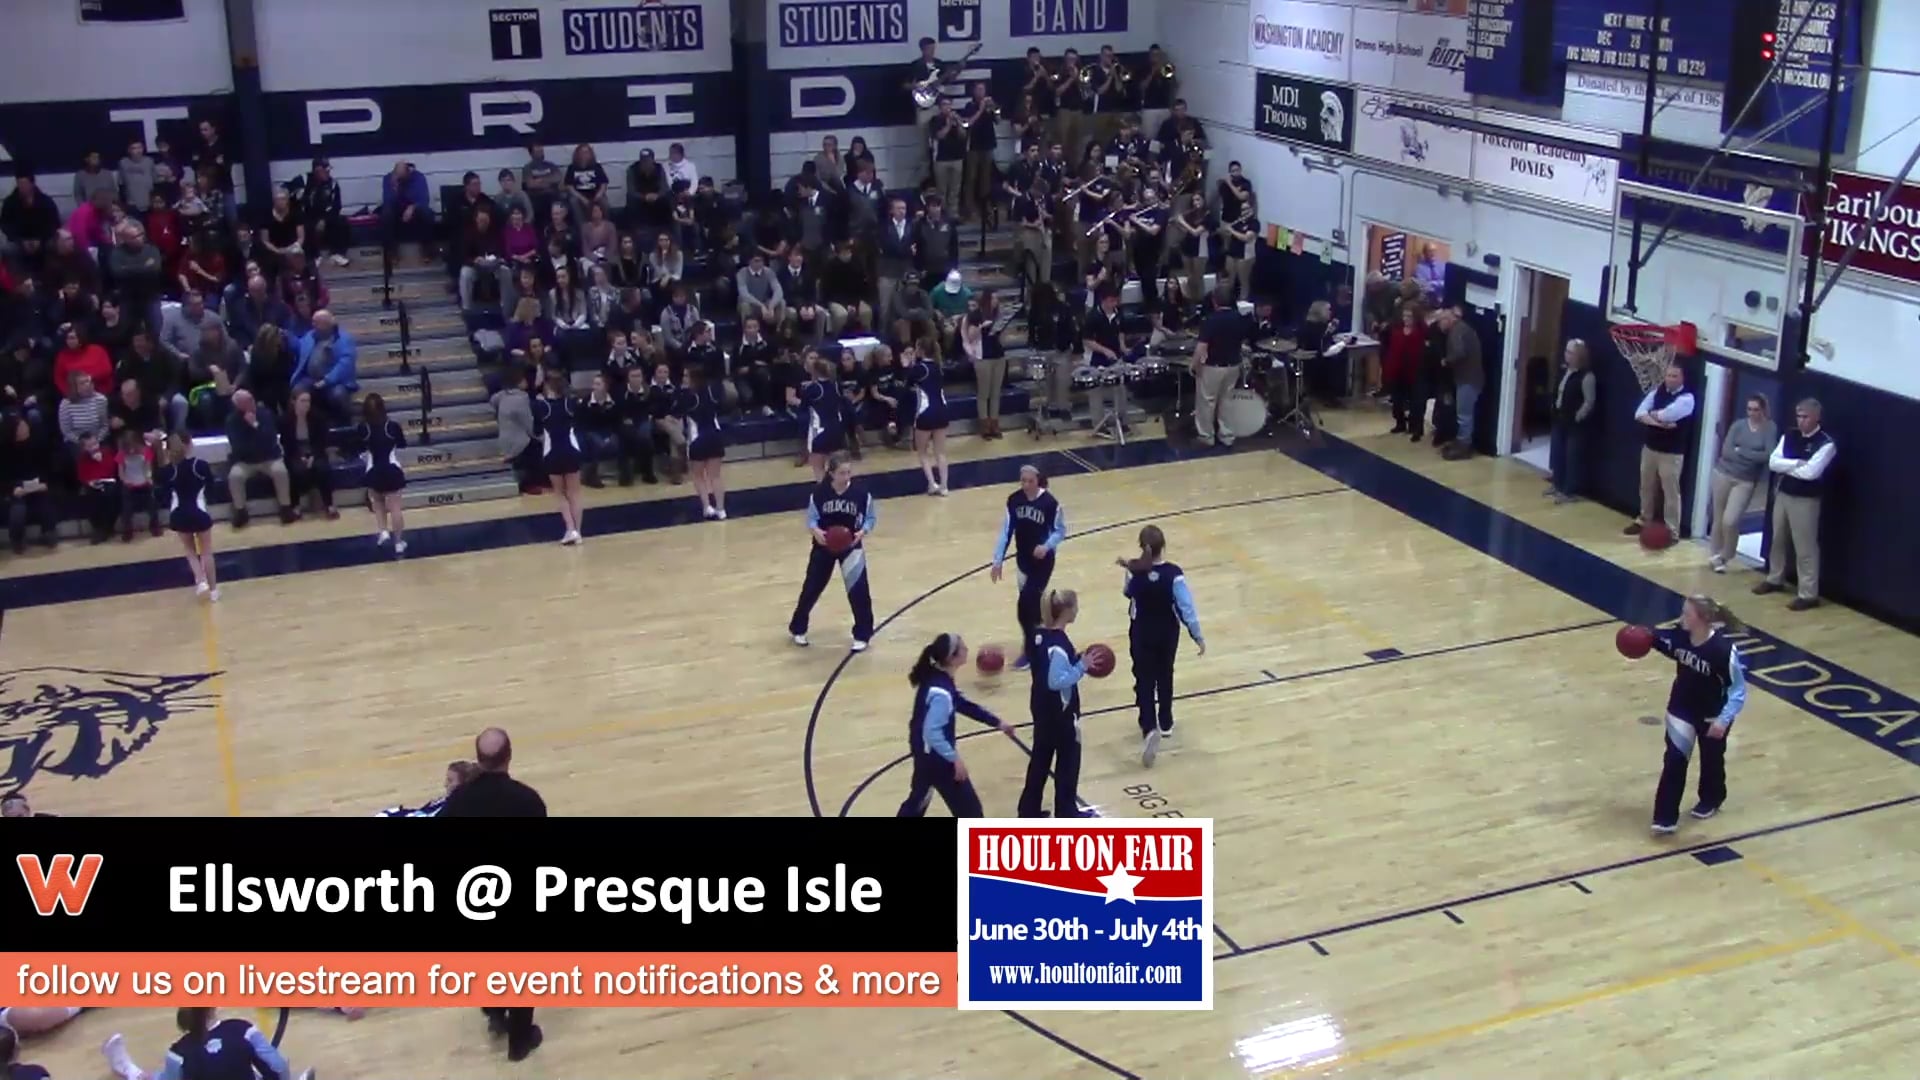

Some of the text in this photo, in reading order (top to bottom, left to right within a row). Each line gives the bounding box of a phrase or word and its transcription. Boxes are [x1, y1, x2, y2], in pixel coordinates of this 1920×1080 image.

[491, 12, 537, 22] SECTION
[784, 3, 903, 43] STUDENTS
[947, 9, 973, 38] J
[1032, 0, 1107, 33] BAND
[510, 25, 522, 56] I
[568, 9, 698, 51] STUDENTS
[1254, 23, 1345, 55] WASHINGTON ACADEMY
[1378, 41, 1395, 56] High
[1271, 84, 1300, 108] MDI
[1578, 75, 1618, 93] Donated
[1621, 80, 1631, 97] by
[1263, 104, 1307, 131] TROJANS
[1510, 156, 1554, 180] PONIES
[417, 454, 443, 464] ROW
[428, 493, 454, 504] ROW
